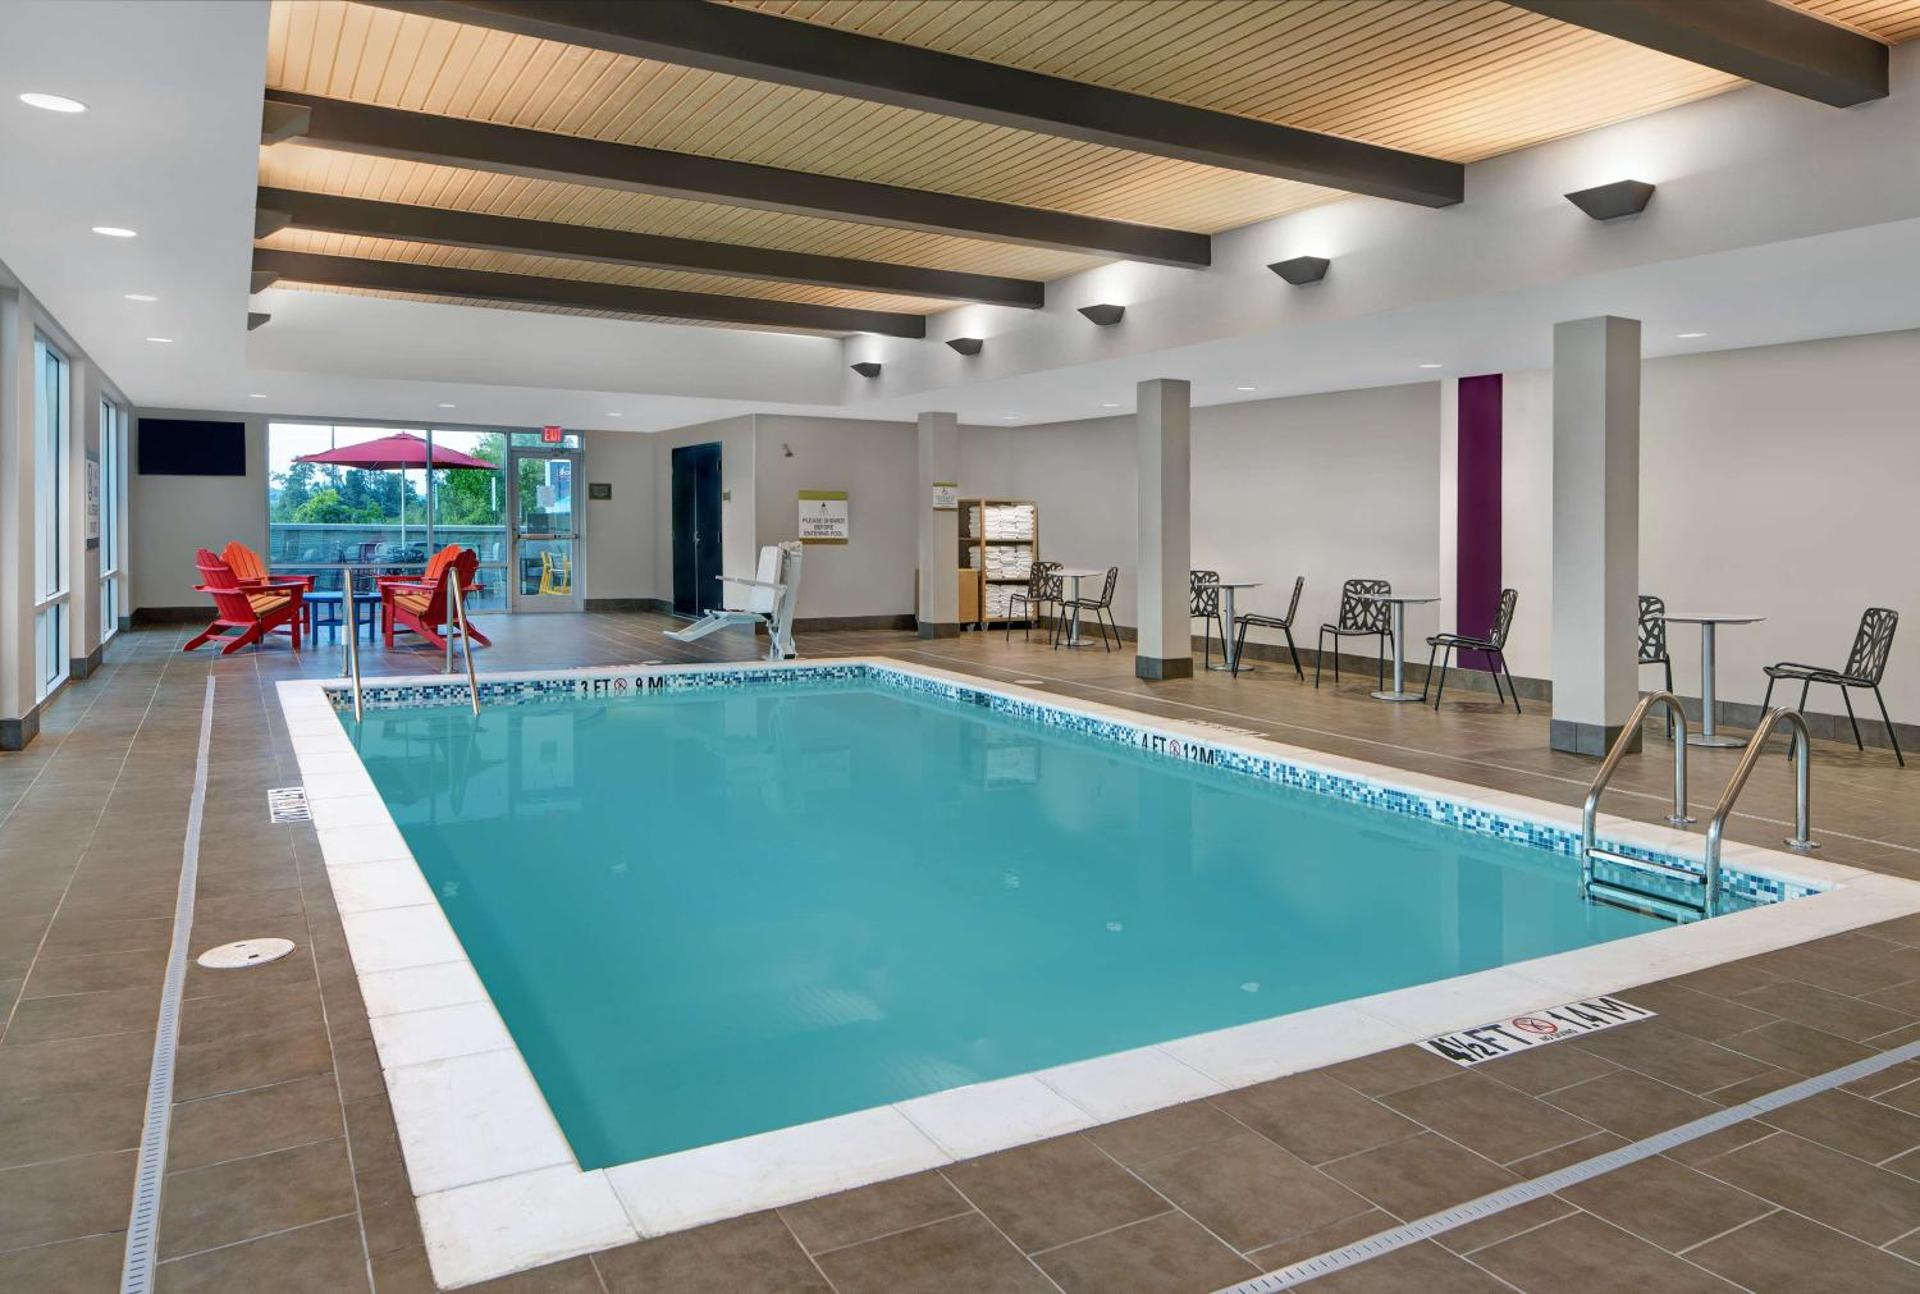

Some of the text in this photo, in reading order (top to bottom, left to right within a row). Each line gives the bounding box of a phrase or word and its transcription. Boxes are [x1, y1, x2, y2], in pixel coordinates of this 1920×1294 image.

[544, 428, 561, 442] EXIT
[594, 679, 611, 693] FT
[648, 676, 664, 688] M
[1141, 733, 1167, 754] 4 FT
